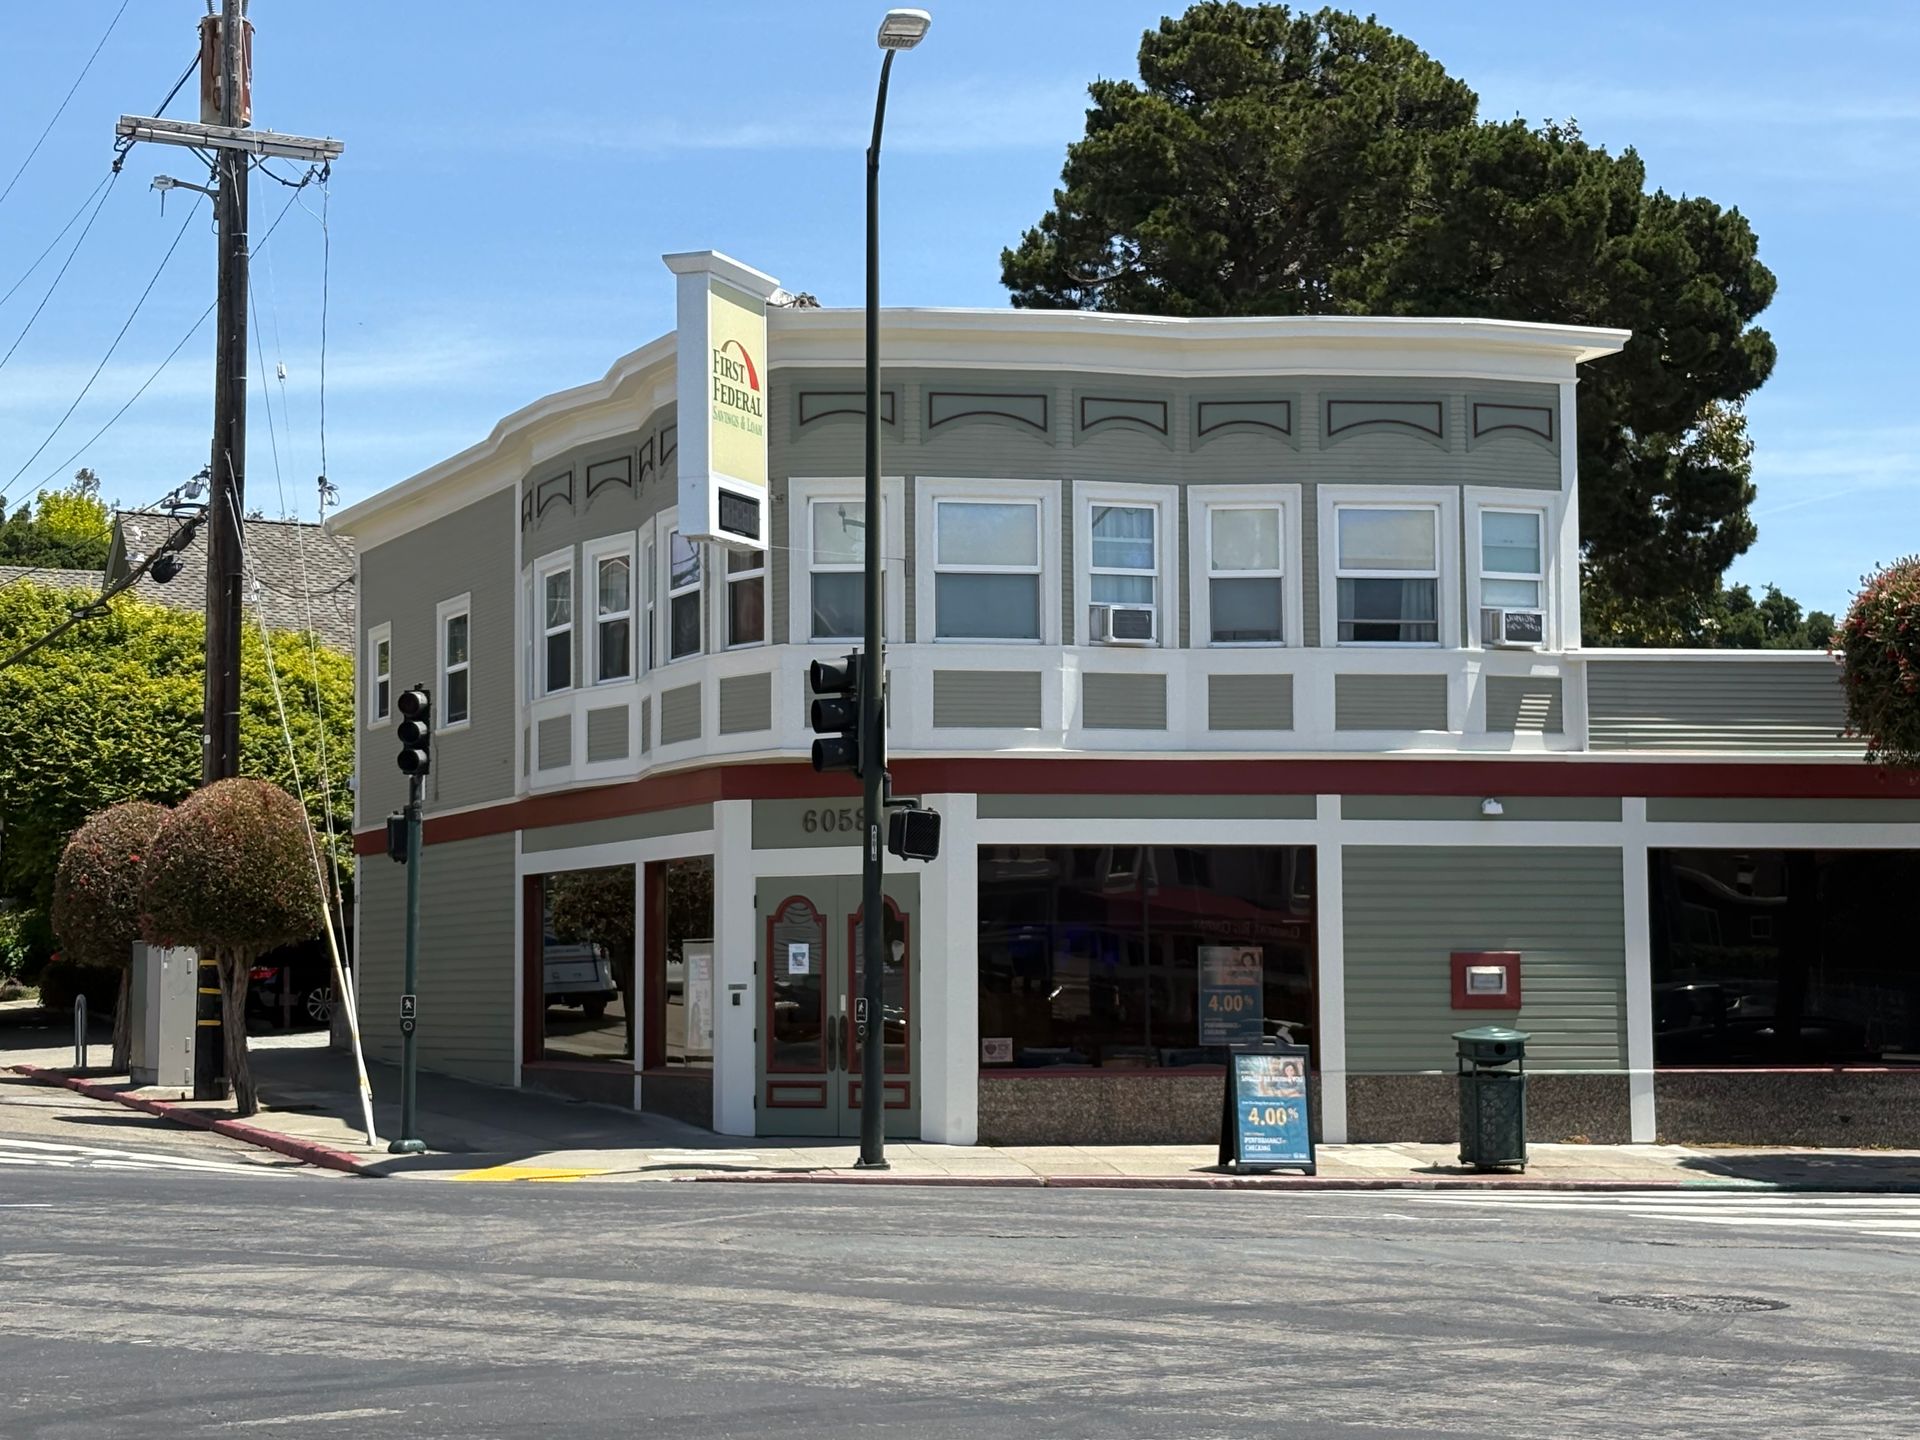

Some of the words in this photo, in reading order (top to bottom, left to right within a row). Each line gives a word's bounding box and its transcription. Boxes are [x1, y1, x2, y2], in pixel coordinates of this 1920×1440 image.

[713, 349, 745, 384] FIRST
[713, 376, 762, 417] FEDERAL
[713, 405, 739, 428] SAVINGS
[740, 415, 746, 431] &
[747, 417, 763, 437] LOAN
